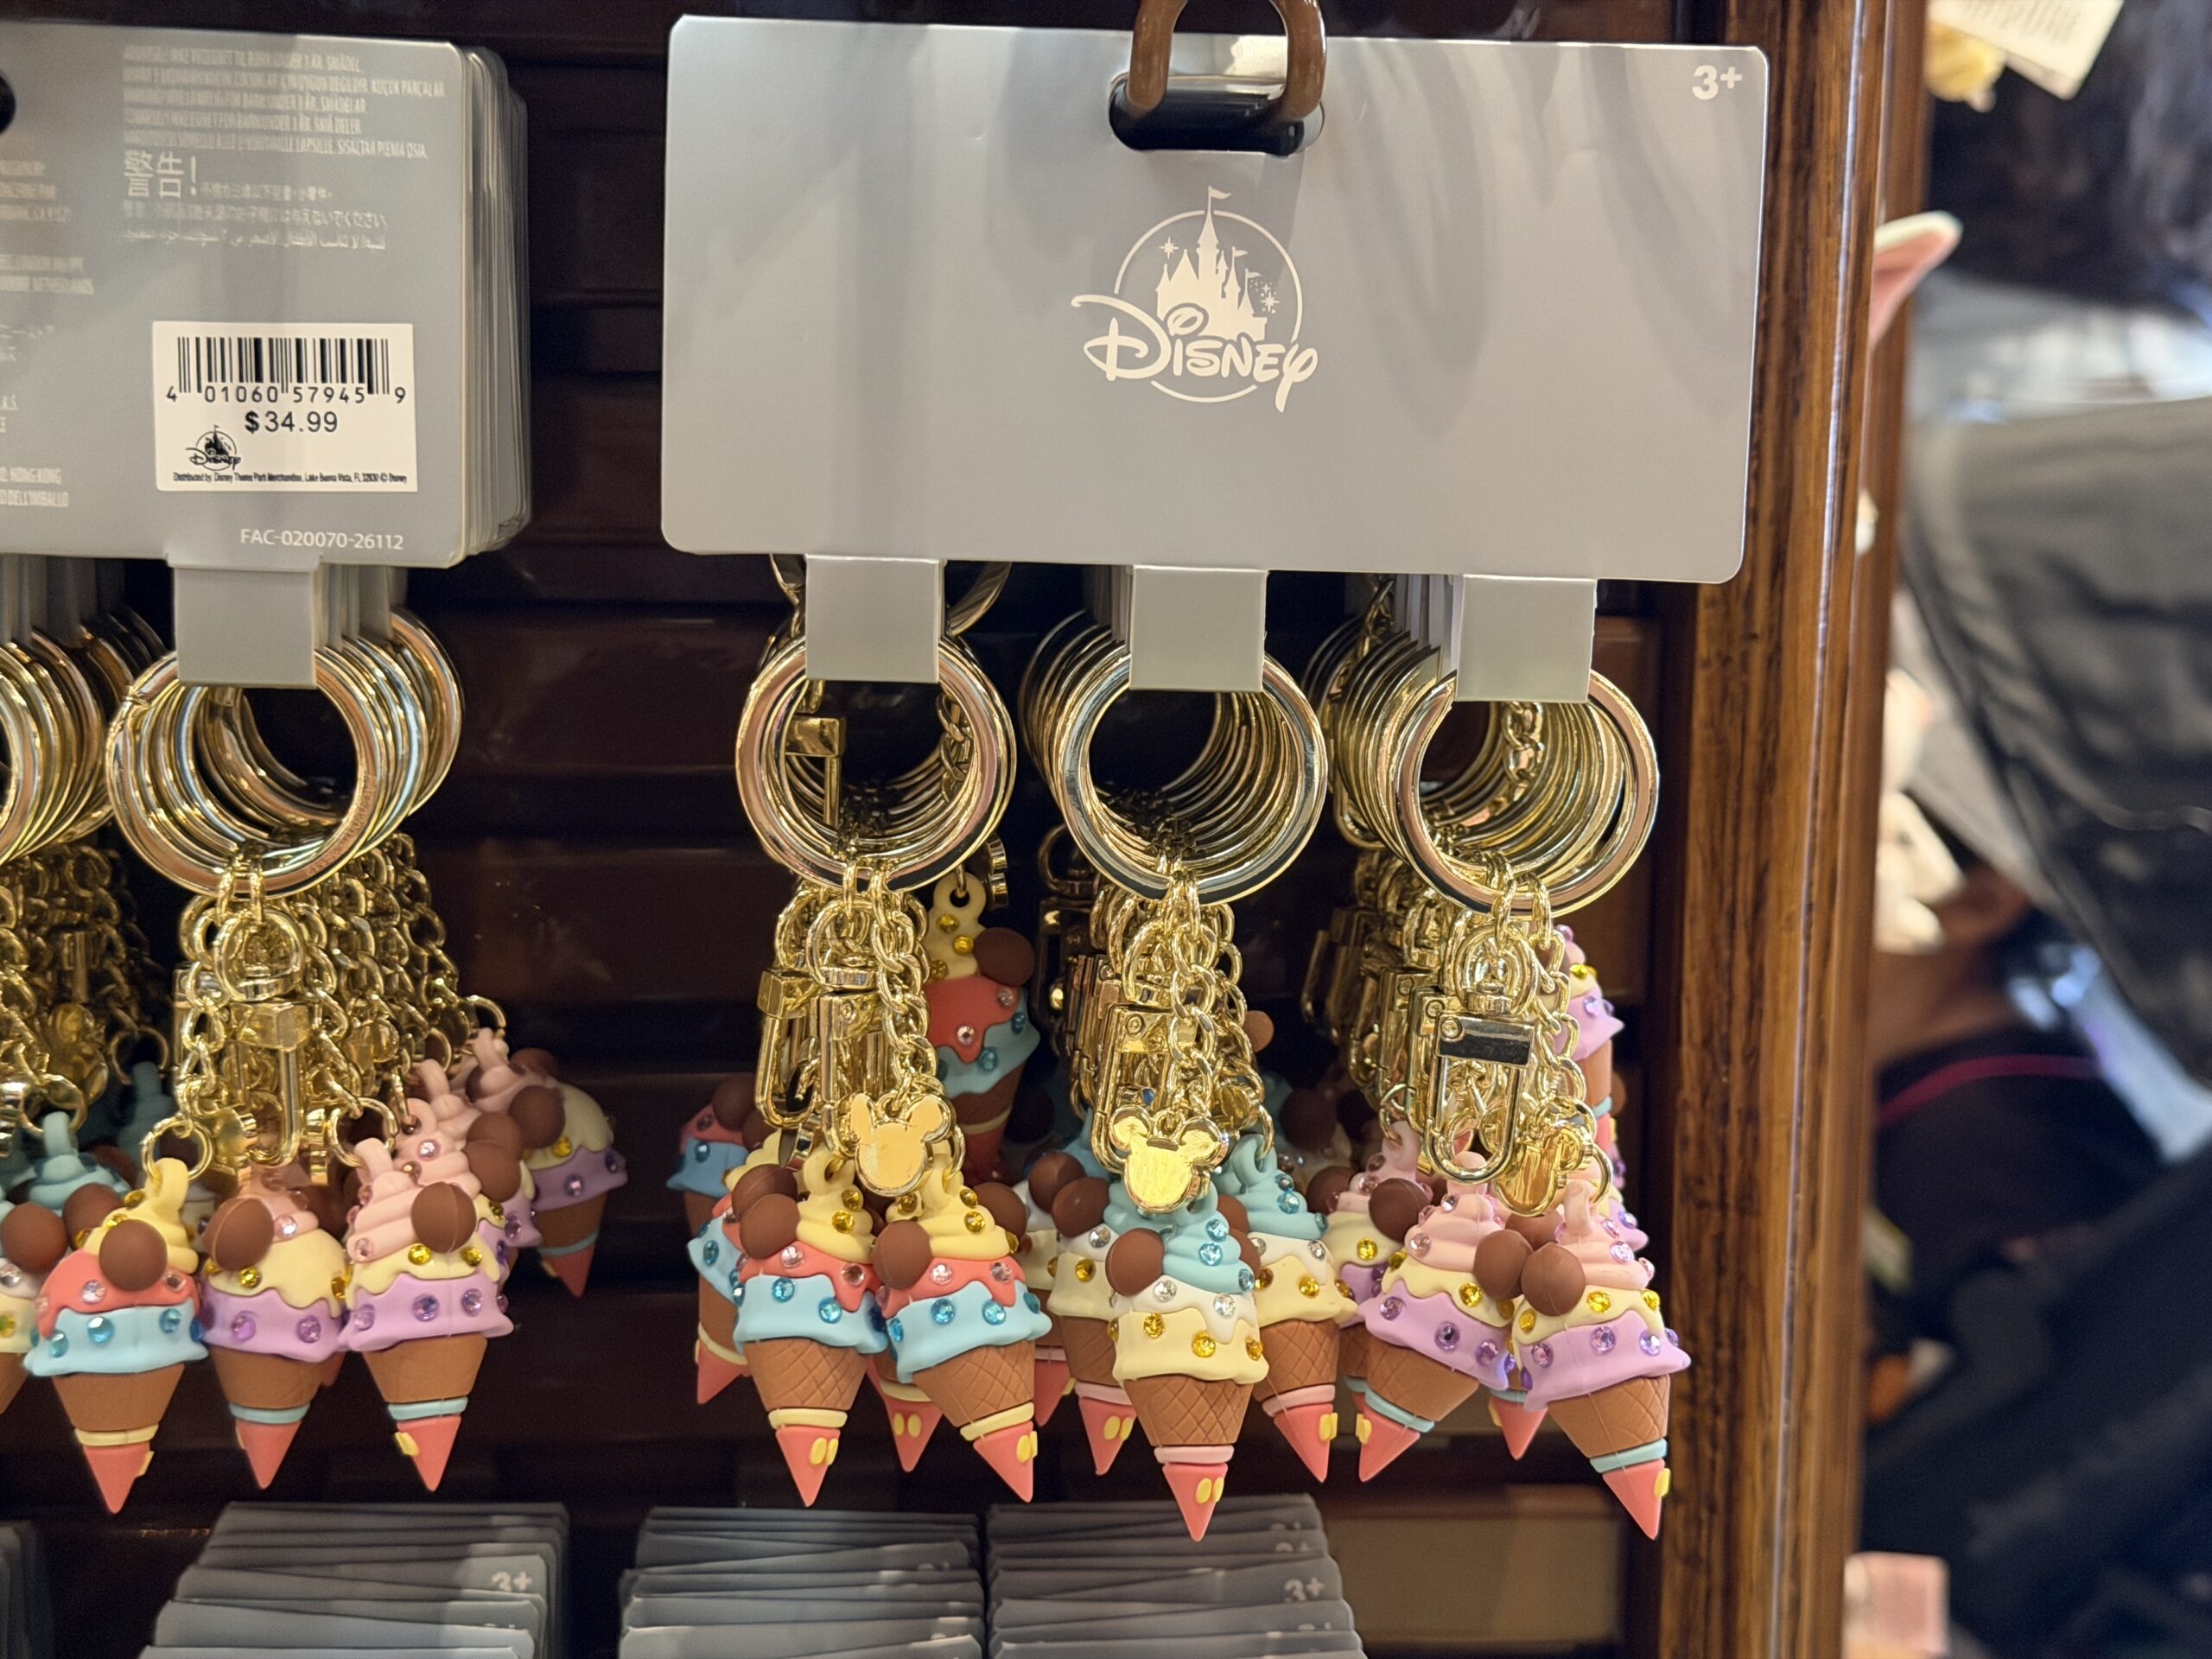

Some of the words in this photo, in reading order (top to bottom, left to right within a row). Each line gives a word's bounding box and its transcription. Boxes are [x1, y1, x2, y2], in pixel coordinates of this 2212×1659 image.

[1692, 65, 1743, 100] 3+
[166, 385, 178, 403] 4
[204, 385, 278, 404] 01060
[292, 385, 365, 404] 57945
[394, 386, 407, 404] 9
[245, 410, 338, 435] $34.99
[240, 528, 404, 550] FAC-020070-26112
